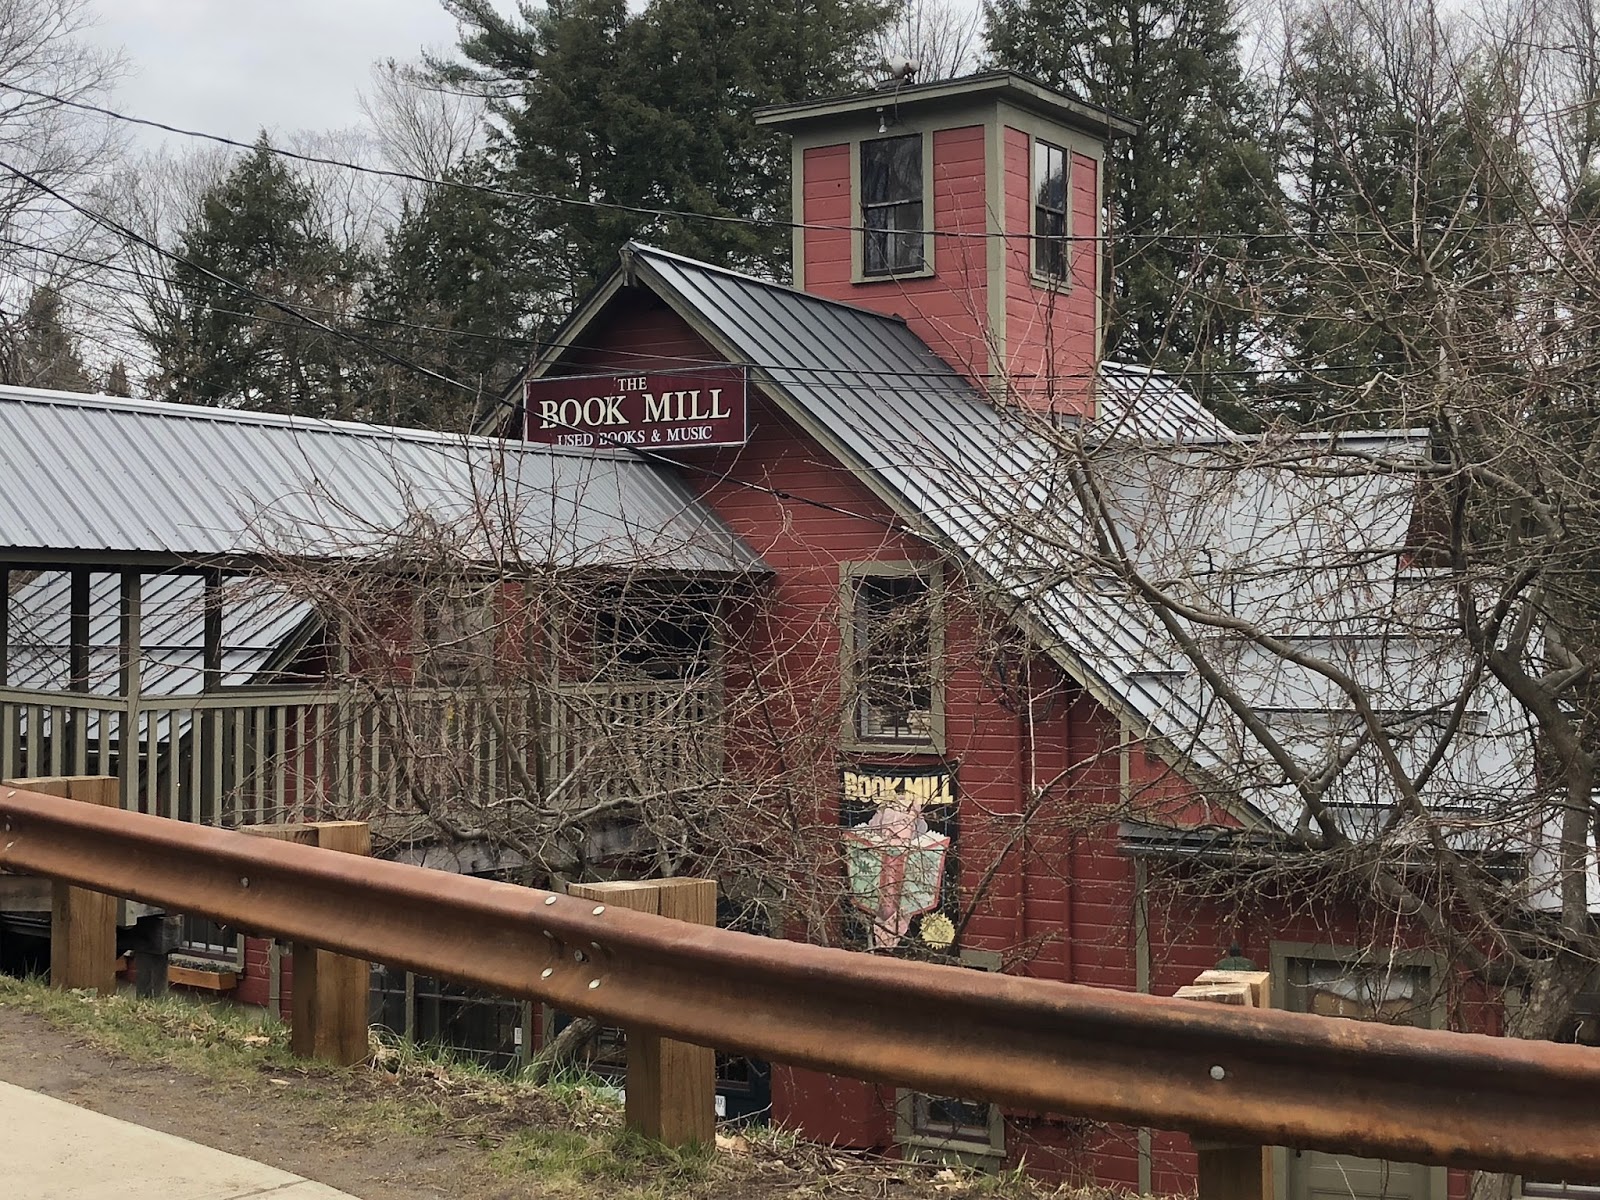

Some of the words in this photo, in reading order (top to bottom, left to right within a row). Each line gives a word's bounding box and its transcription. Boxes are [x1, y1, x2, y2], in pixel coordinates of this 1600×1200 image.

[617, 376, 648, 392] THE
[539, 395, 630, 429] BOOK
[642, 388, 731, 423] MILL
[557, 433, 594, 447] USED
[599, 429, 646, 446] BOOKS
[650, 431, 662, 443] &
[666, 425, 713, 441] MUSIC
[843, 771, 903, 805] BOOK
[904, 774, 954, 805] MILL
